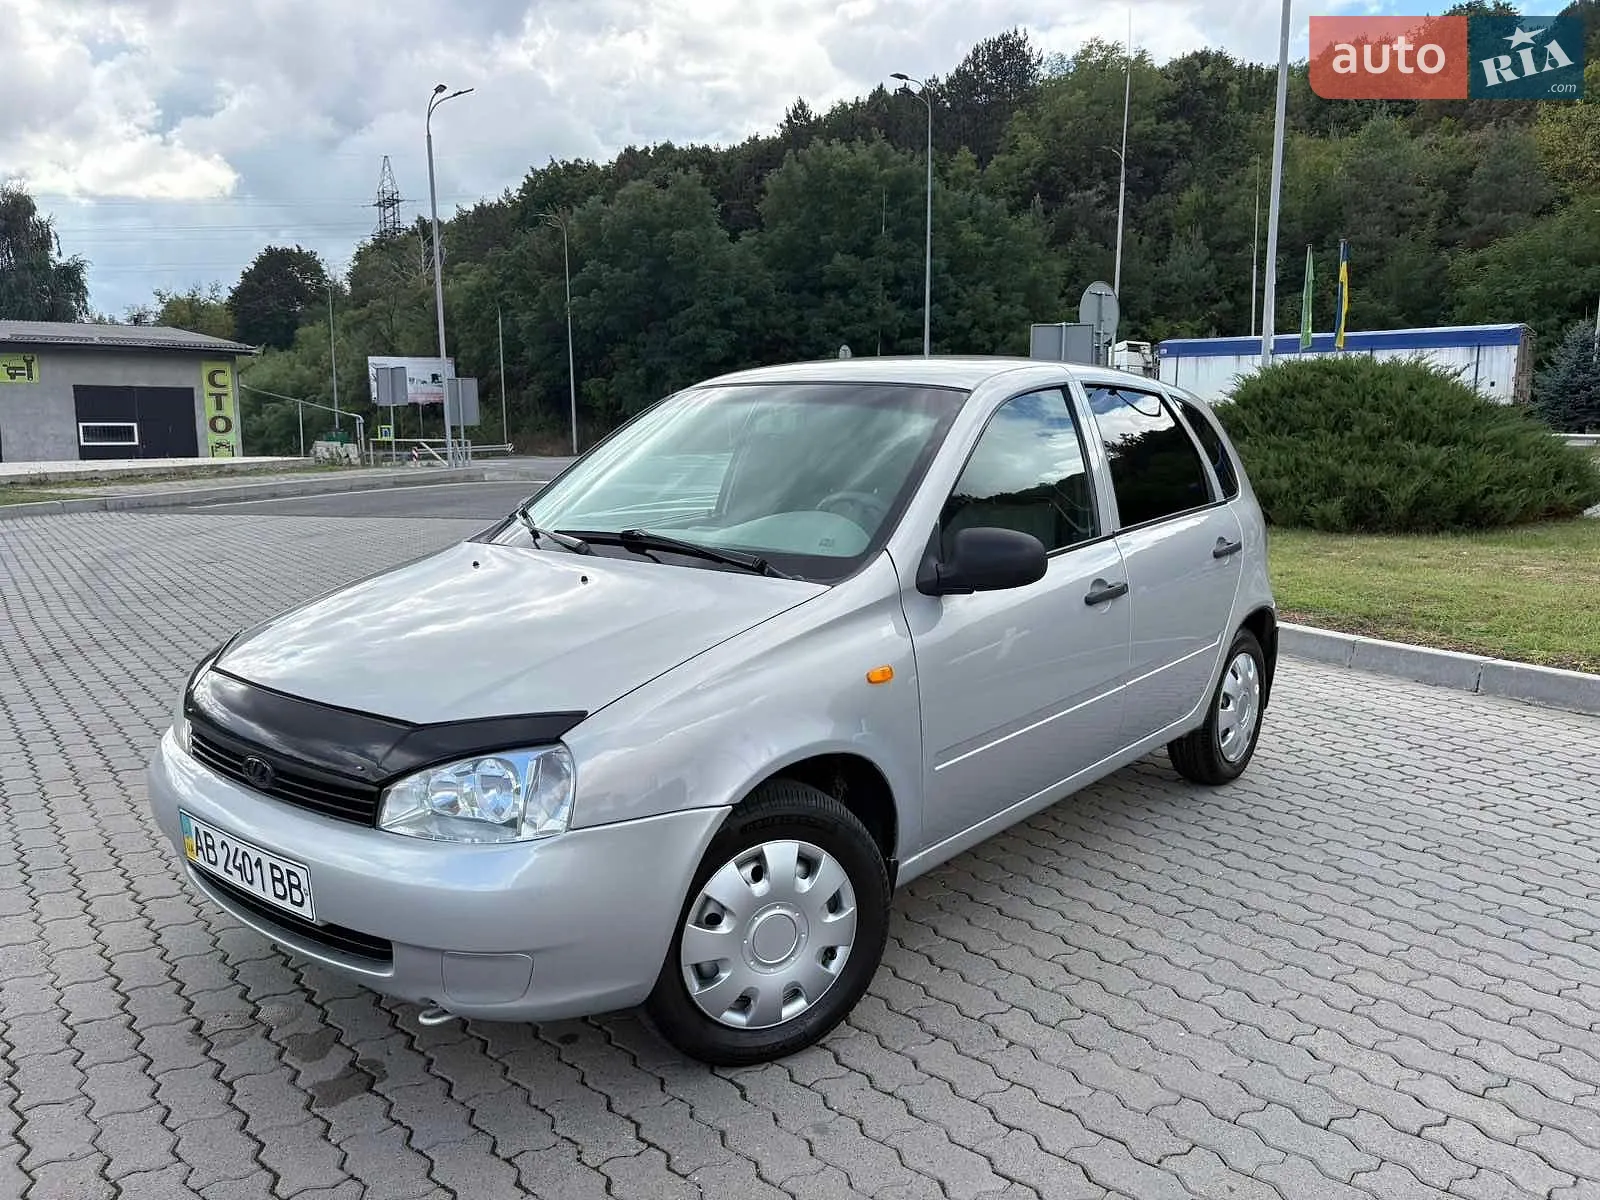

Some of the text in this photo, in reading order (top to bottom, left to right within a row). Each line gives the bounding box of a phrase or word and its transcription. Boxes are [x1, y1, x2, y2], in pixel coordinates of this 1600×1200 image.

[208, 369, 233, 434] СТО
[194, 826, 305, 907] AB 2401 BB
